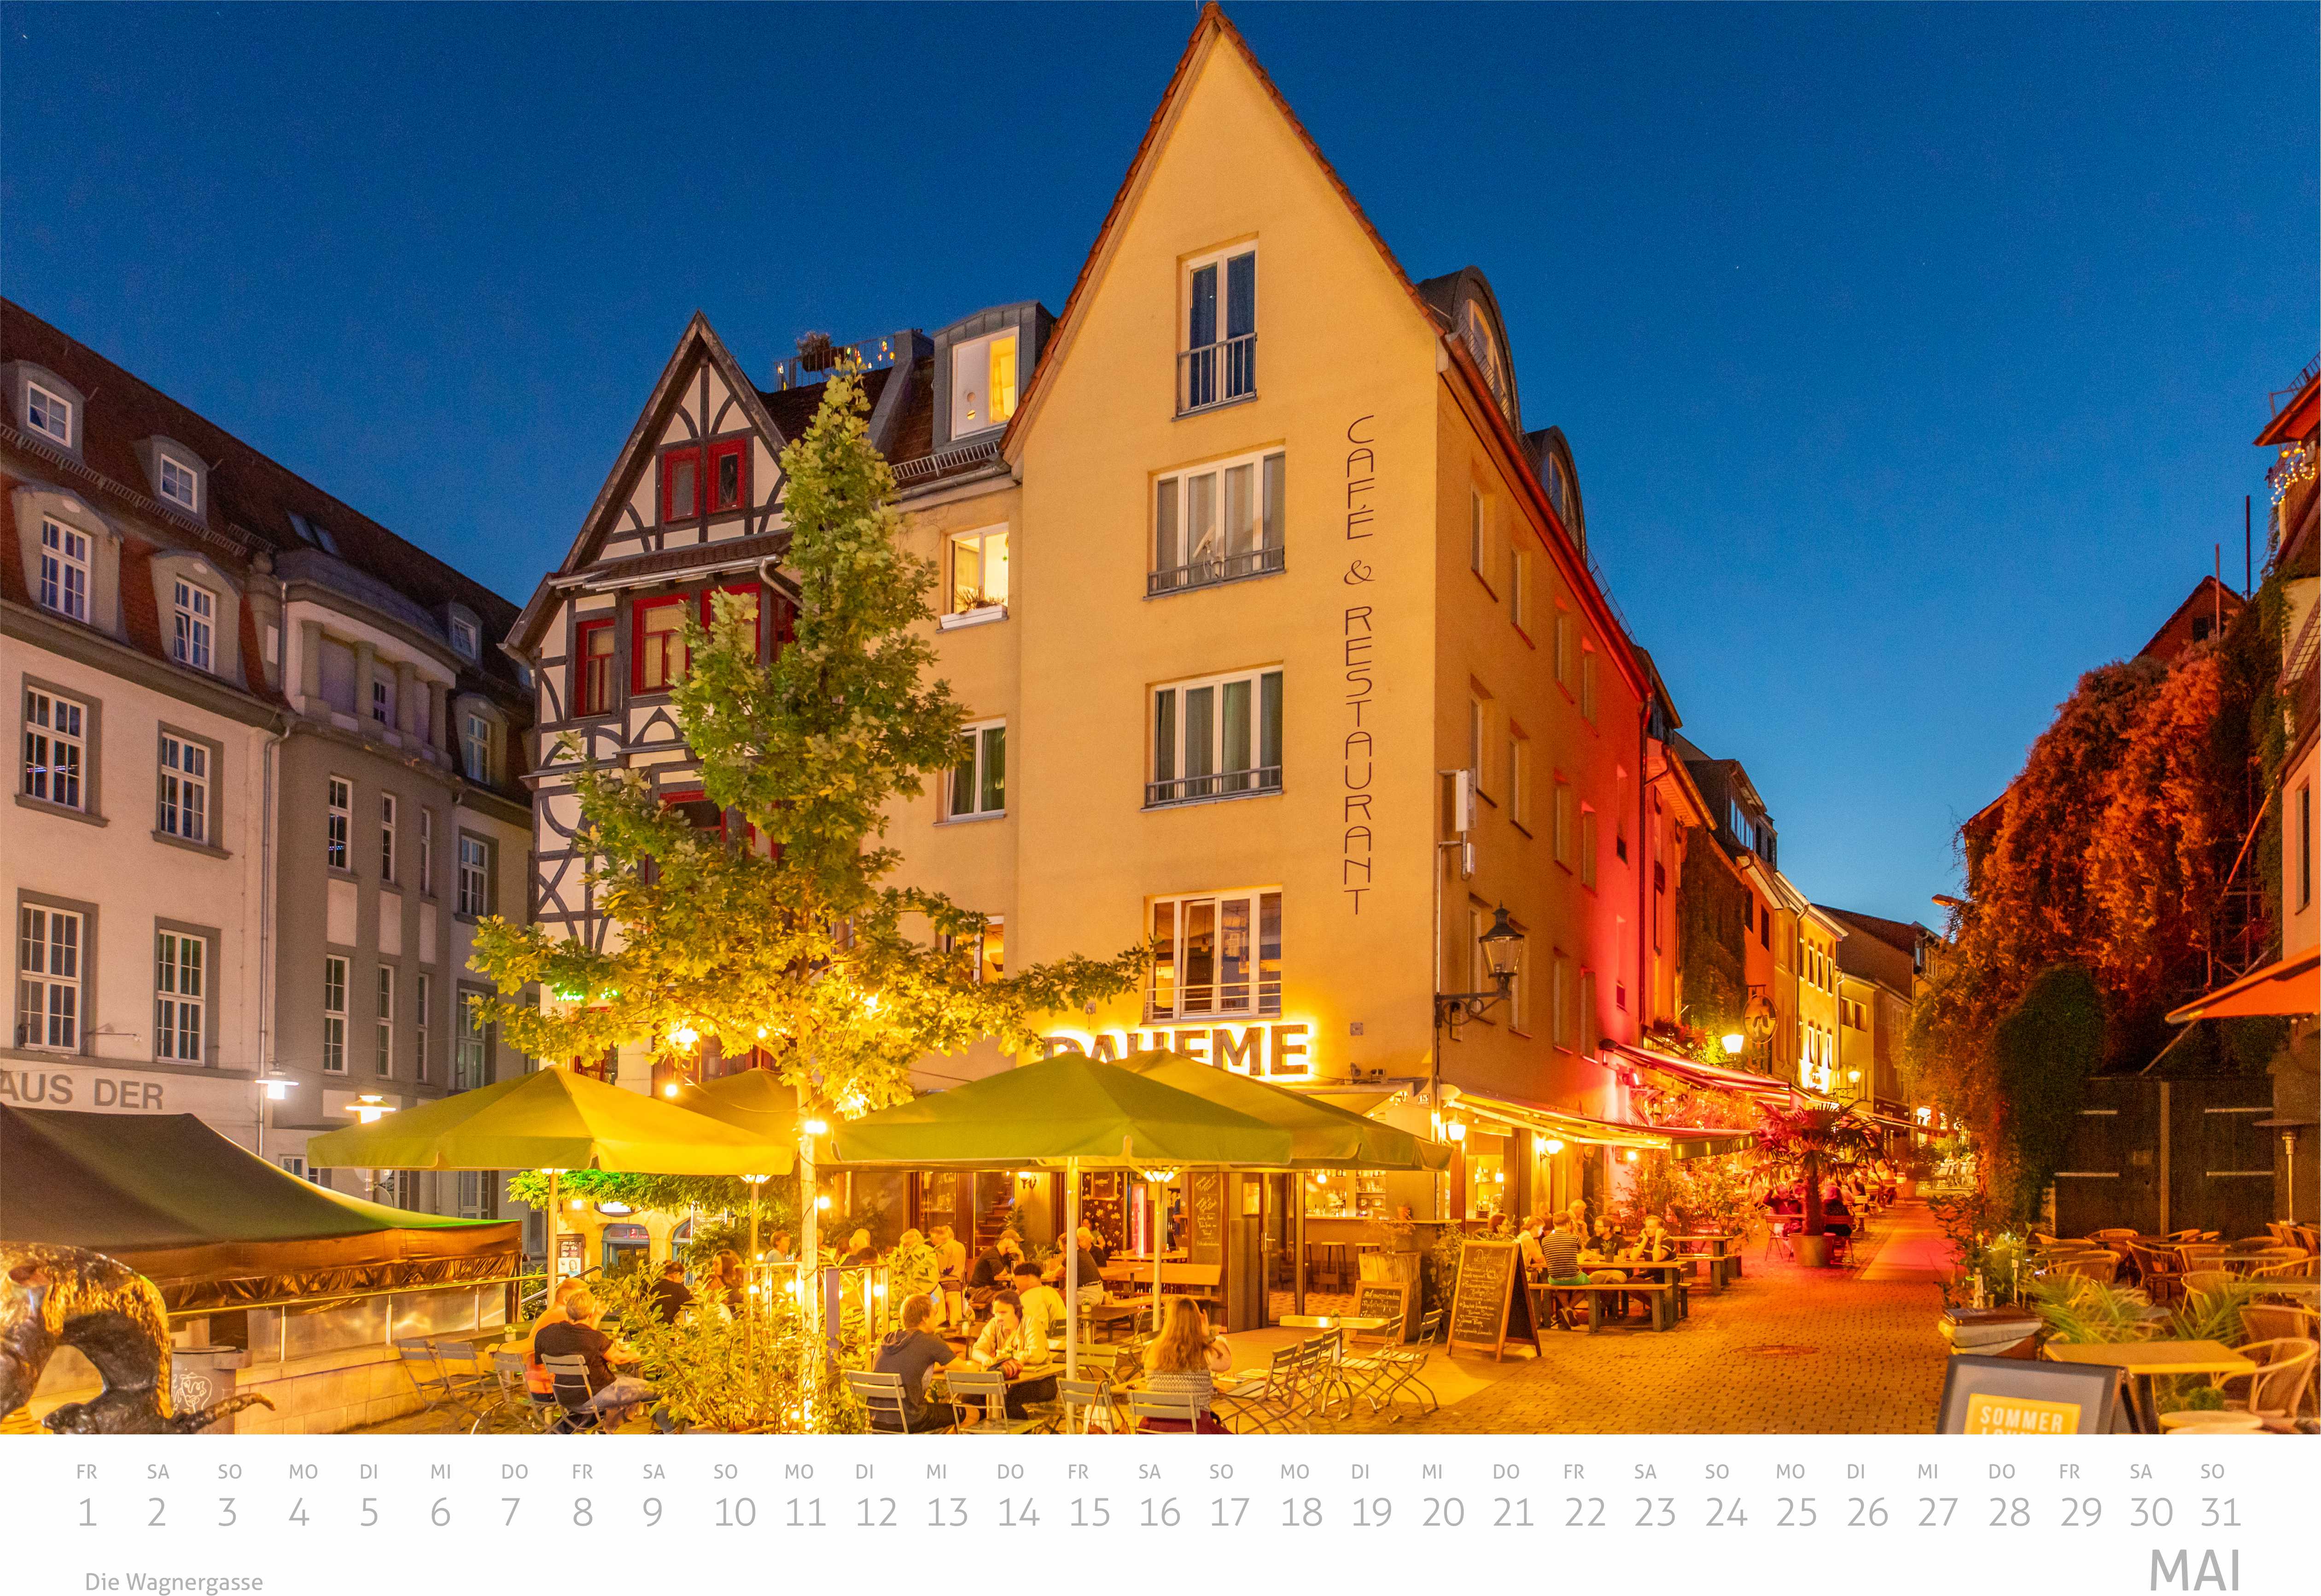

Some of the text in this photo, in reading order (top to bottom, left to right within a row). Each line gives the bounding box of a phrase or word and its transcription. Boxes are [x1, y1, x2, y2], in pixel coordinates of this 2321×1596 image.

[1343, 415, 1376, 915] CAFÉ & RESTAURANT
[94, 1078, 164, 1110] DER
[1980, 1406, 2063, 1433] SOMMER
